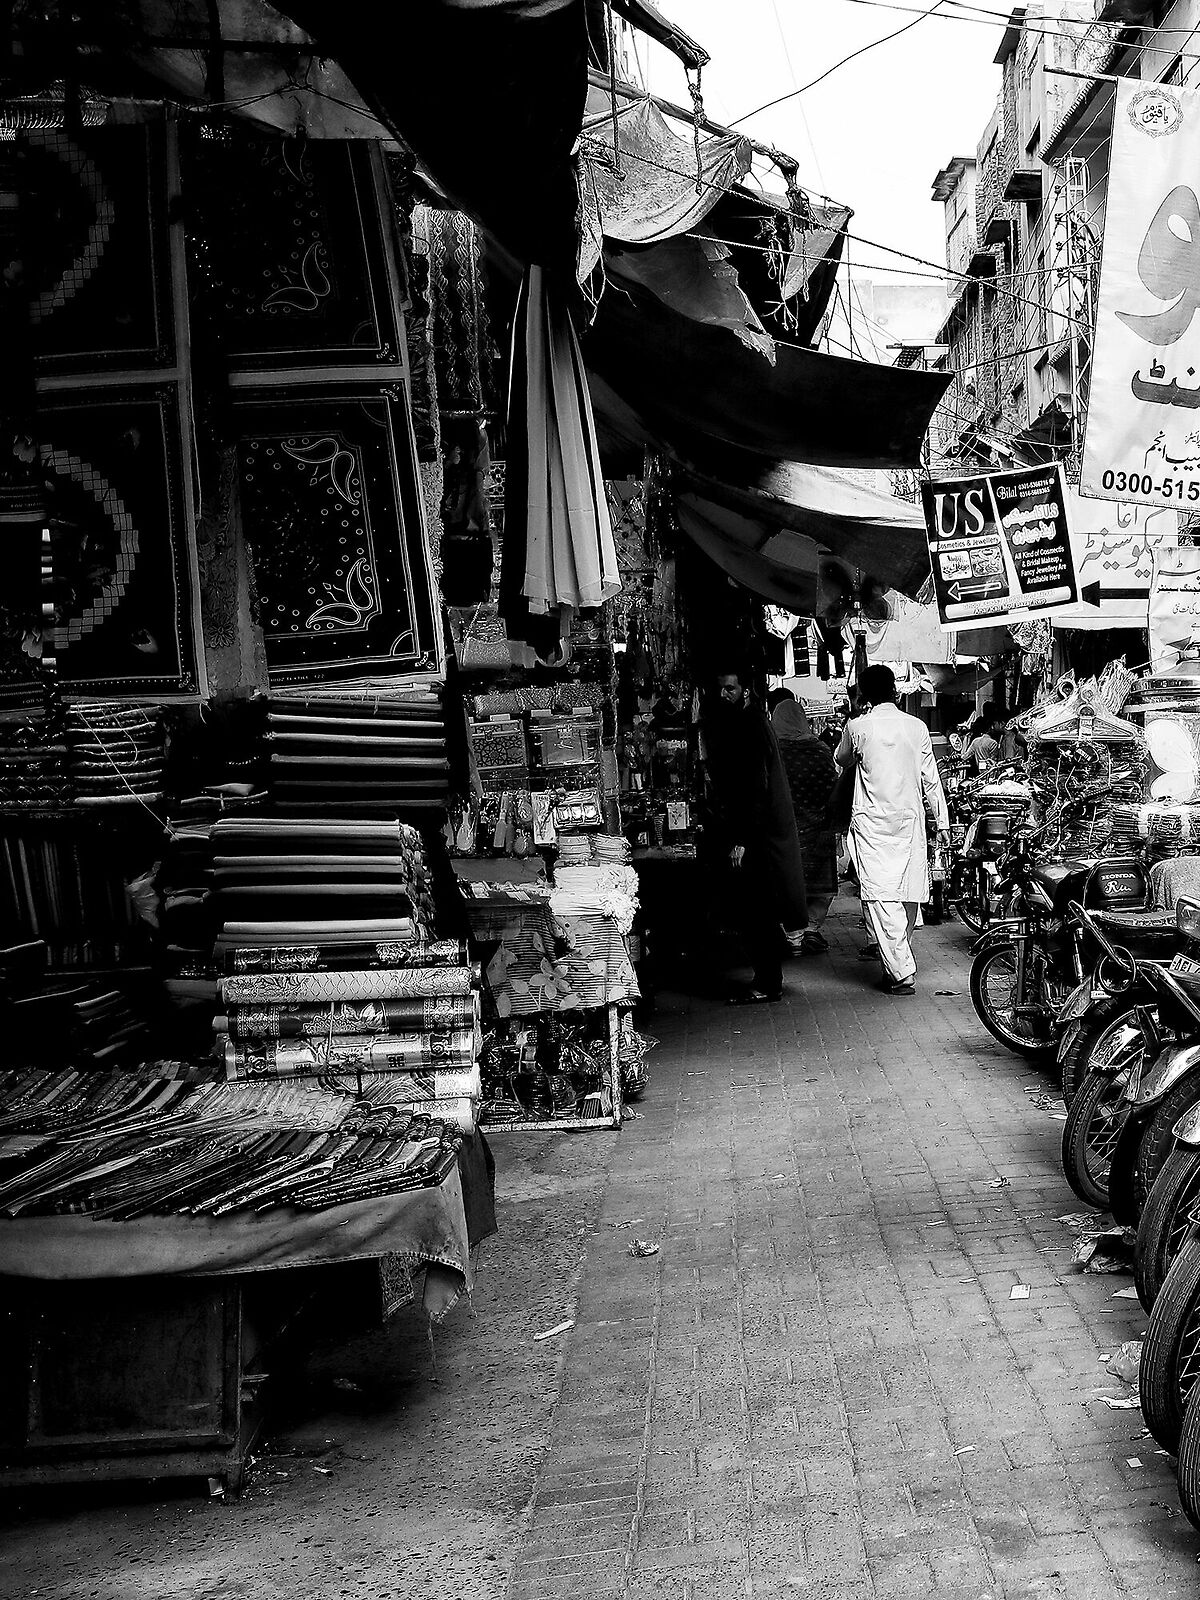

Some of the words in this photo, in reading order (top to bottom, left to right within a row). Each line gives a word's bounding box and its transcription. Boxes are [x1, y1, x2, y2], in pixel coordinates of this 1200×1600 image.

[1144, 430, 1166, 469] انجم
[996, 486, 1017, 499] Bilal
[934, 489, 984, 538] US
[1023, 550, 1034, 558] Kind
[1027, 558, 1040, 567] Bridal
[1021, 569, 1035, 577] Fancy
[1049, 573, 1061, 581] Here
